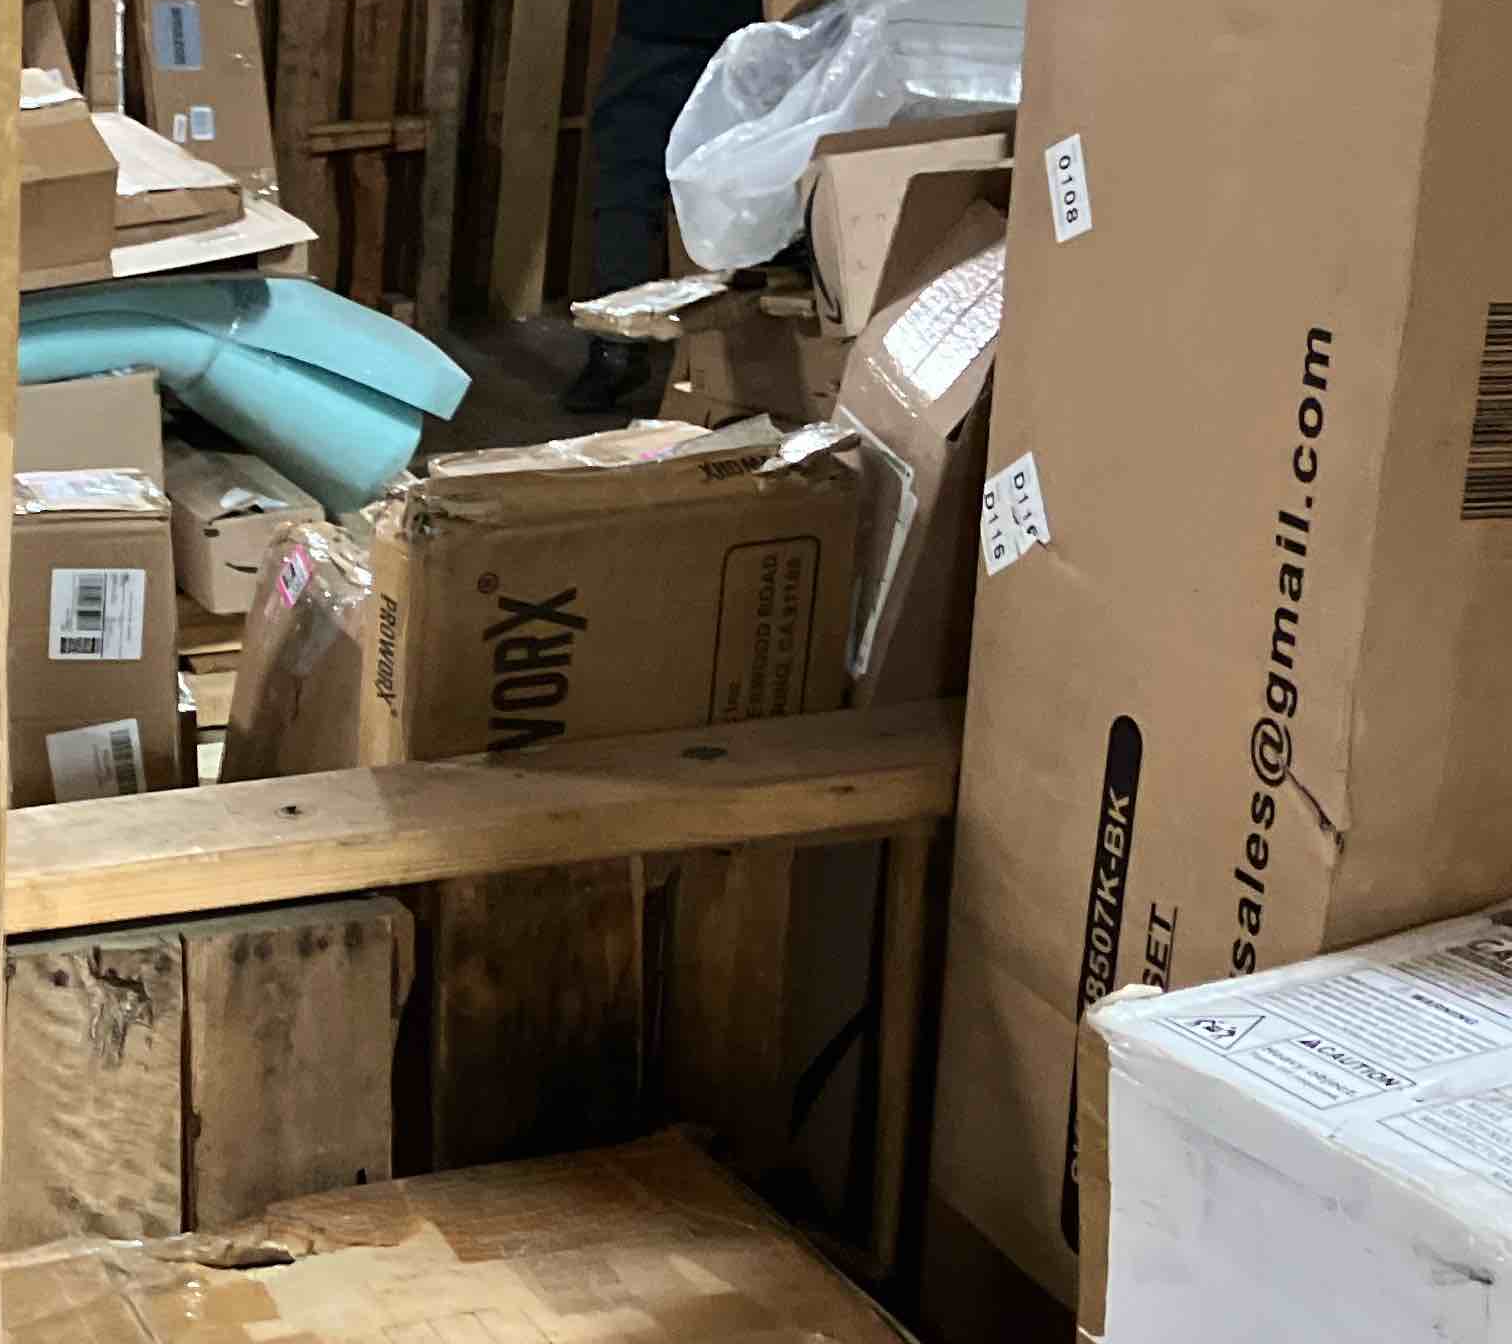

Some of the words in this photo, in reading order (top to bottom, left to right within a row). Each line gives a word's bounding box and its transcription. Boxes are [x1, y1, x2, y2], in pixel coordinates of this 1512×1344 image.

[1055, 153, 1081, 225] 0108
[984, 492, 1006, 561] D116
[1316, 1044, 1400, 1089] CAUTION
